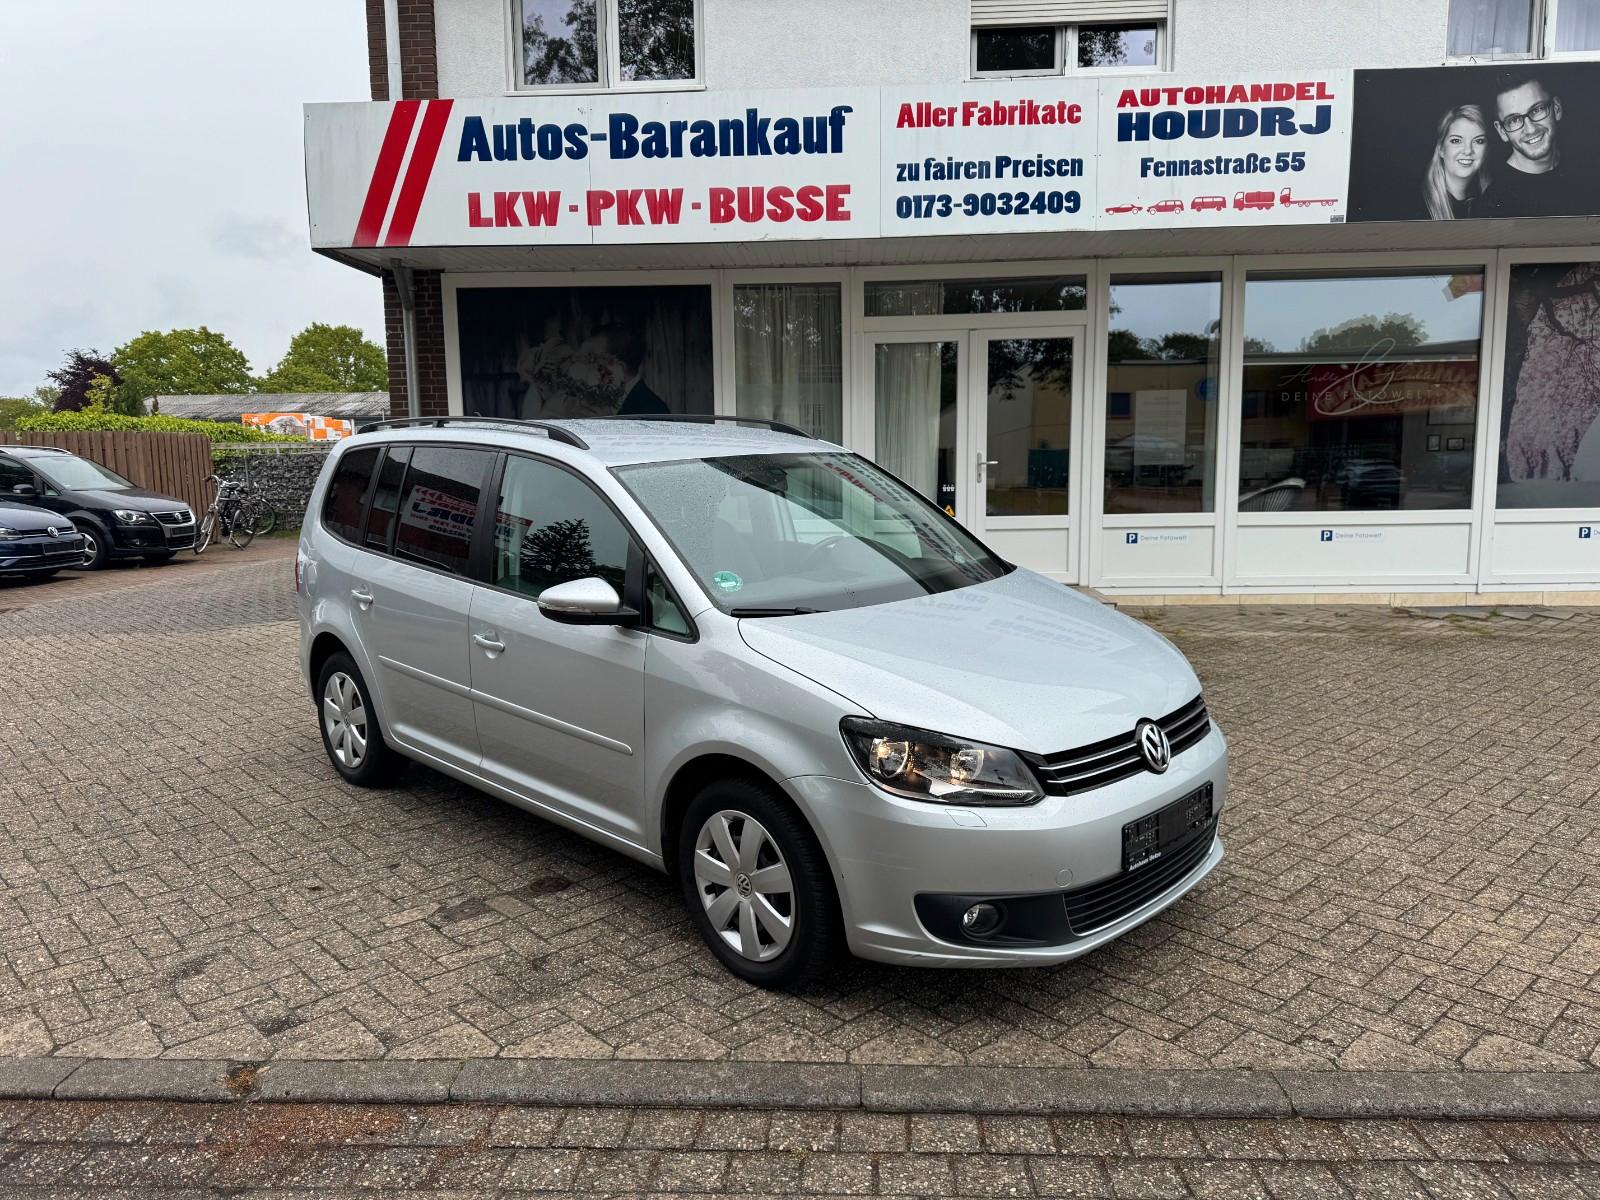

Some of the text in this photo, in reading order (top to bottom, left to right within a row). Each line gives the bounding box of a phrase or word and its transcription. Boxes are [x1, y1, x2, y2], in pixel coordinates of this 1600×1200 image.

[1117, 82, 1335, 108] AUTOHANDEL
[897, 100, 1081, 128] Aller Fabrikate
[1118, 104, 1332, 142] HOUDRJ
[457, 105, 853, 162] Autos-Barankauf
[897, 154, 1083, 182] zu fairen Preisen
[1140, 152, 1306, 177] Fennastraße 55
[468, 185, 852, 227] LKW PKW BUSSE
[896, 190, 1081, 219] 0173-9032409
[1281, 389, 1432, 402] DEINE FOTOWELT
